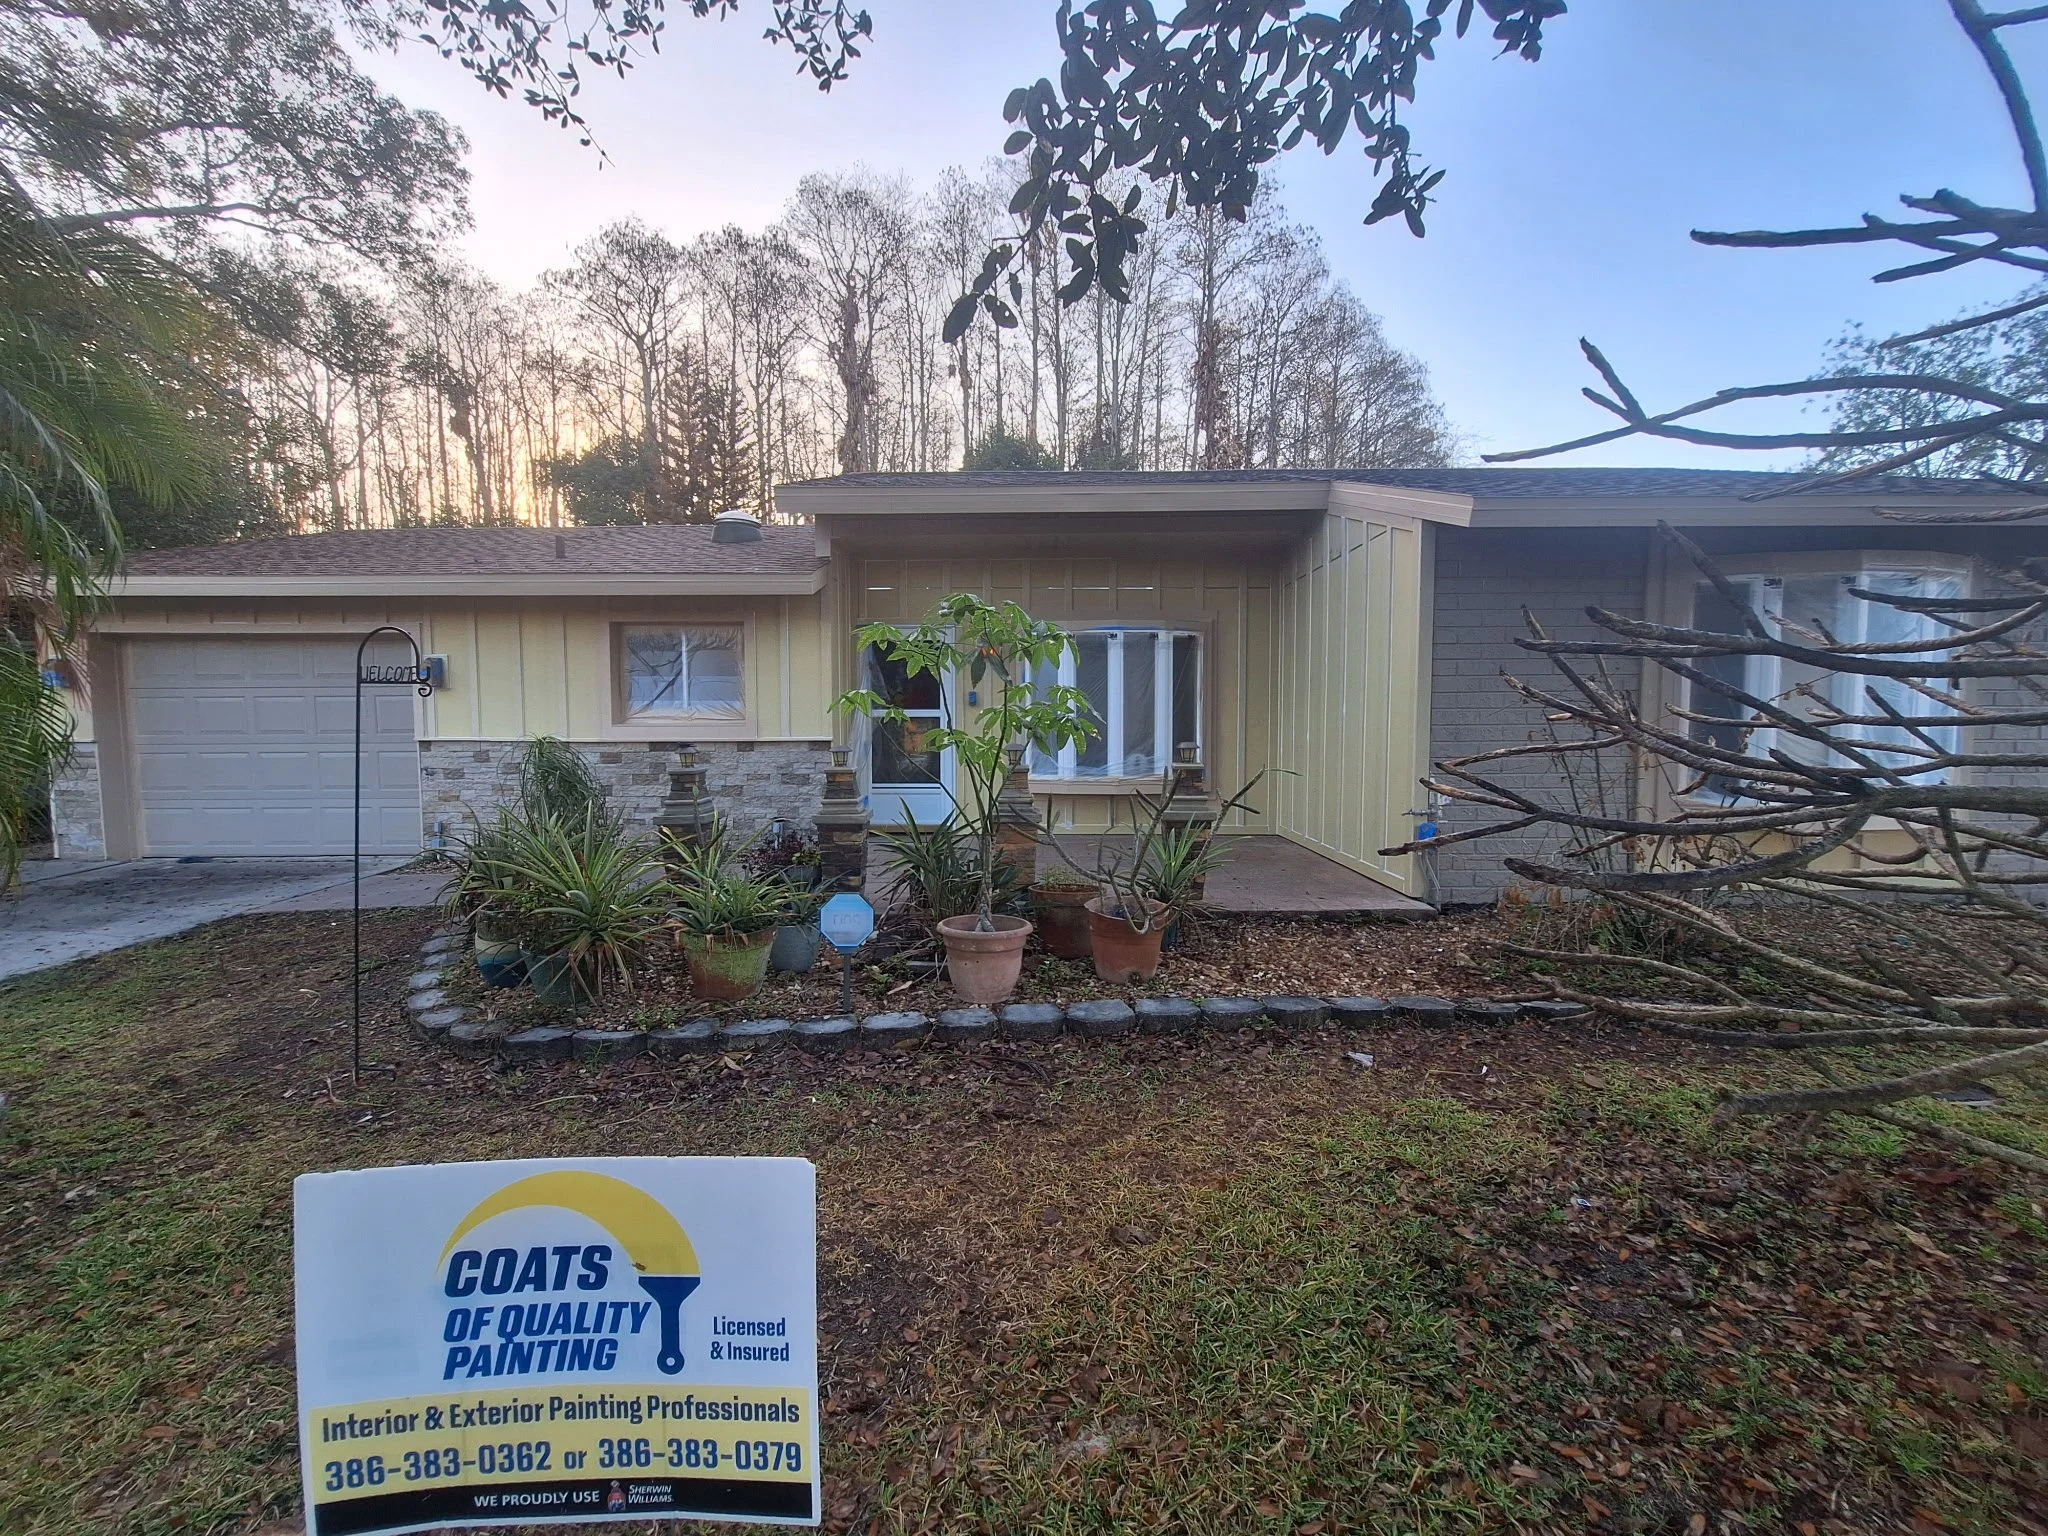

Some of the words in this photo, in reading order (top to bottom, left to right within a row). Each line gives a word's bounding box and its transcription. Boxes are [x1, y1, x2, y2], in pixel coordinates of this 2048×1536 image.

[444, 1244, 613, 1298] COATS
[443, 1306, 495, 1343] OF
[497, 1301, 653, 1346] QUALITY
[713, 1315, 787, 1338] Licensed
[443, 1337, 619, 1381] PAINTING
[710, 1343, 724, 1361] &
[727, 1342, 791, 1363] Insured
[322, 1408, 419, 1443] Interior
[424, 1406, 445, 1431] &
[450, 1397, 545, 1430] Exterior
[549, 1393, 644, 1426] Painting
[647, 1394, 801, 1424] Professionals
[325, 1440, 552, 1493] 386-383-0362
[563, 1449, 588, 1471] or
[598, 1437, 802, 1474] 386-383-0379
[474, 1495, 498, 1508] WE
[502, 1491, 569, 1506] PROUDLY
[573, 1490, 600, 1504] USE
[628, 1494, 673, 1504] WILLIAMS
[629, 1484, 672, 1495] SHERWIN
